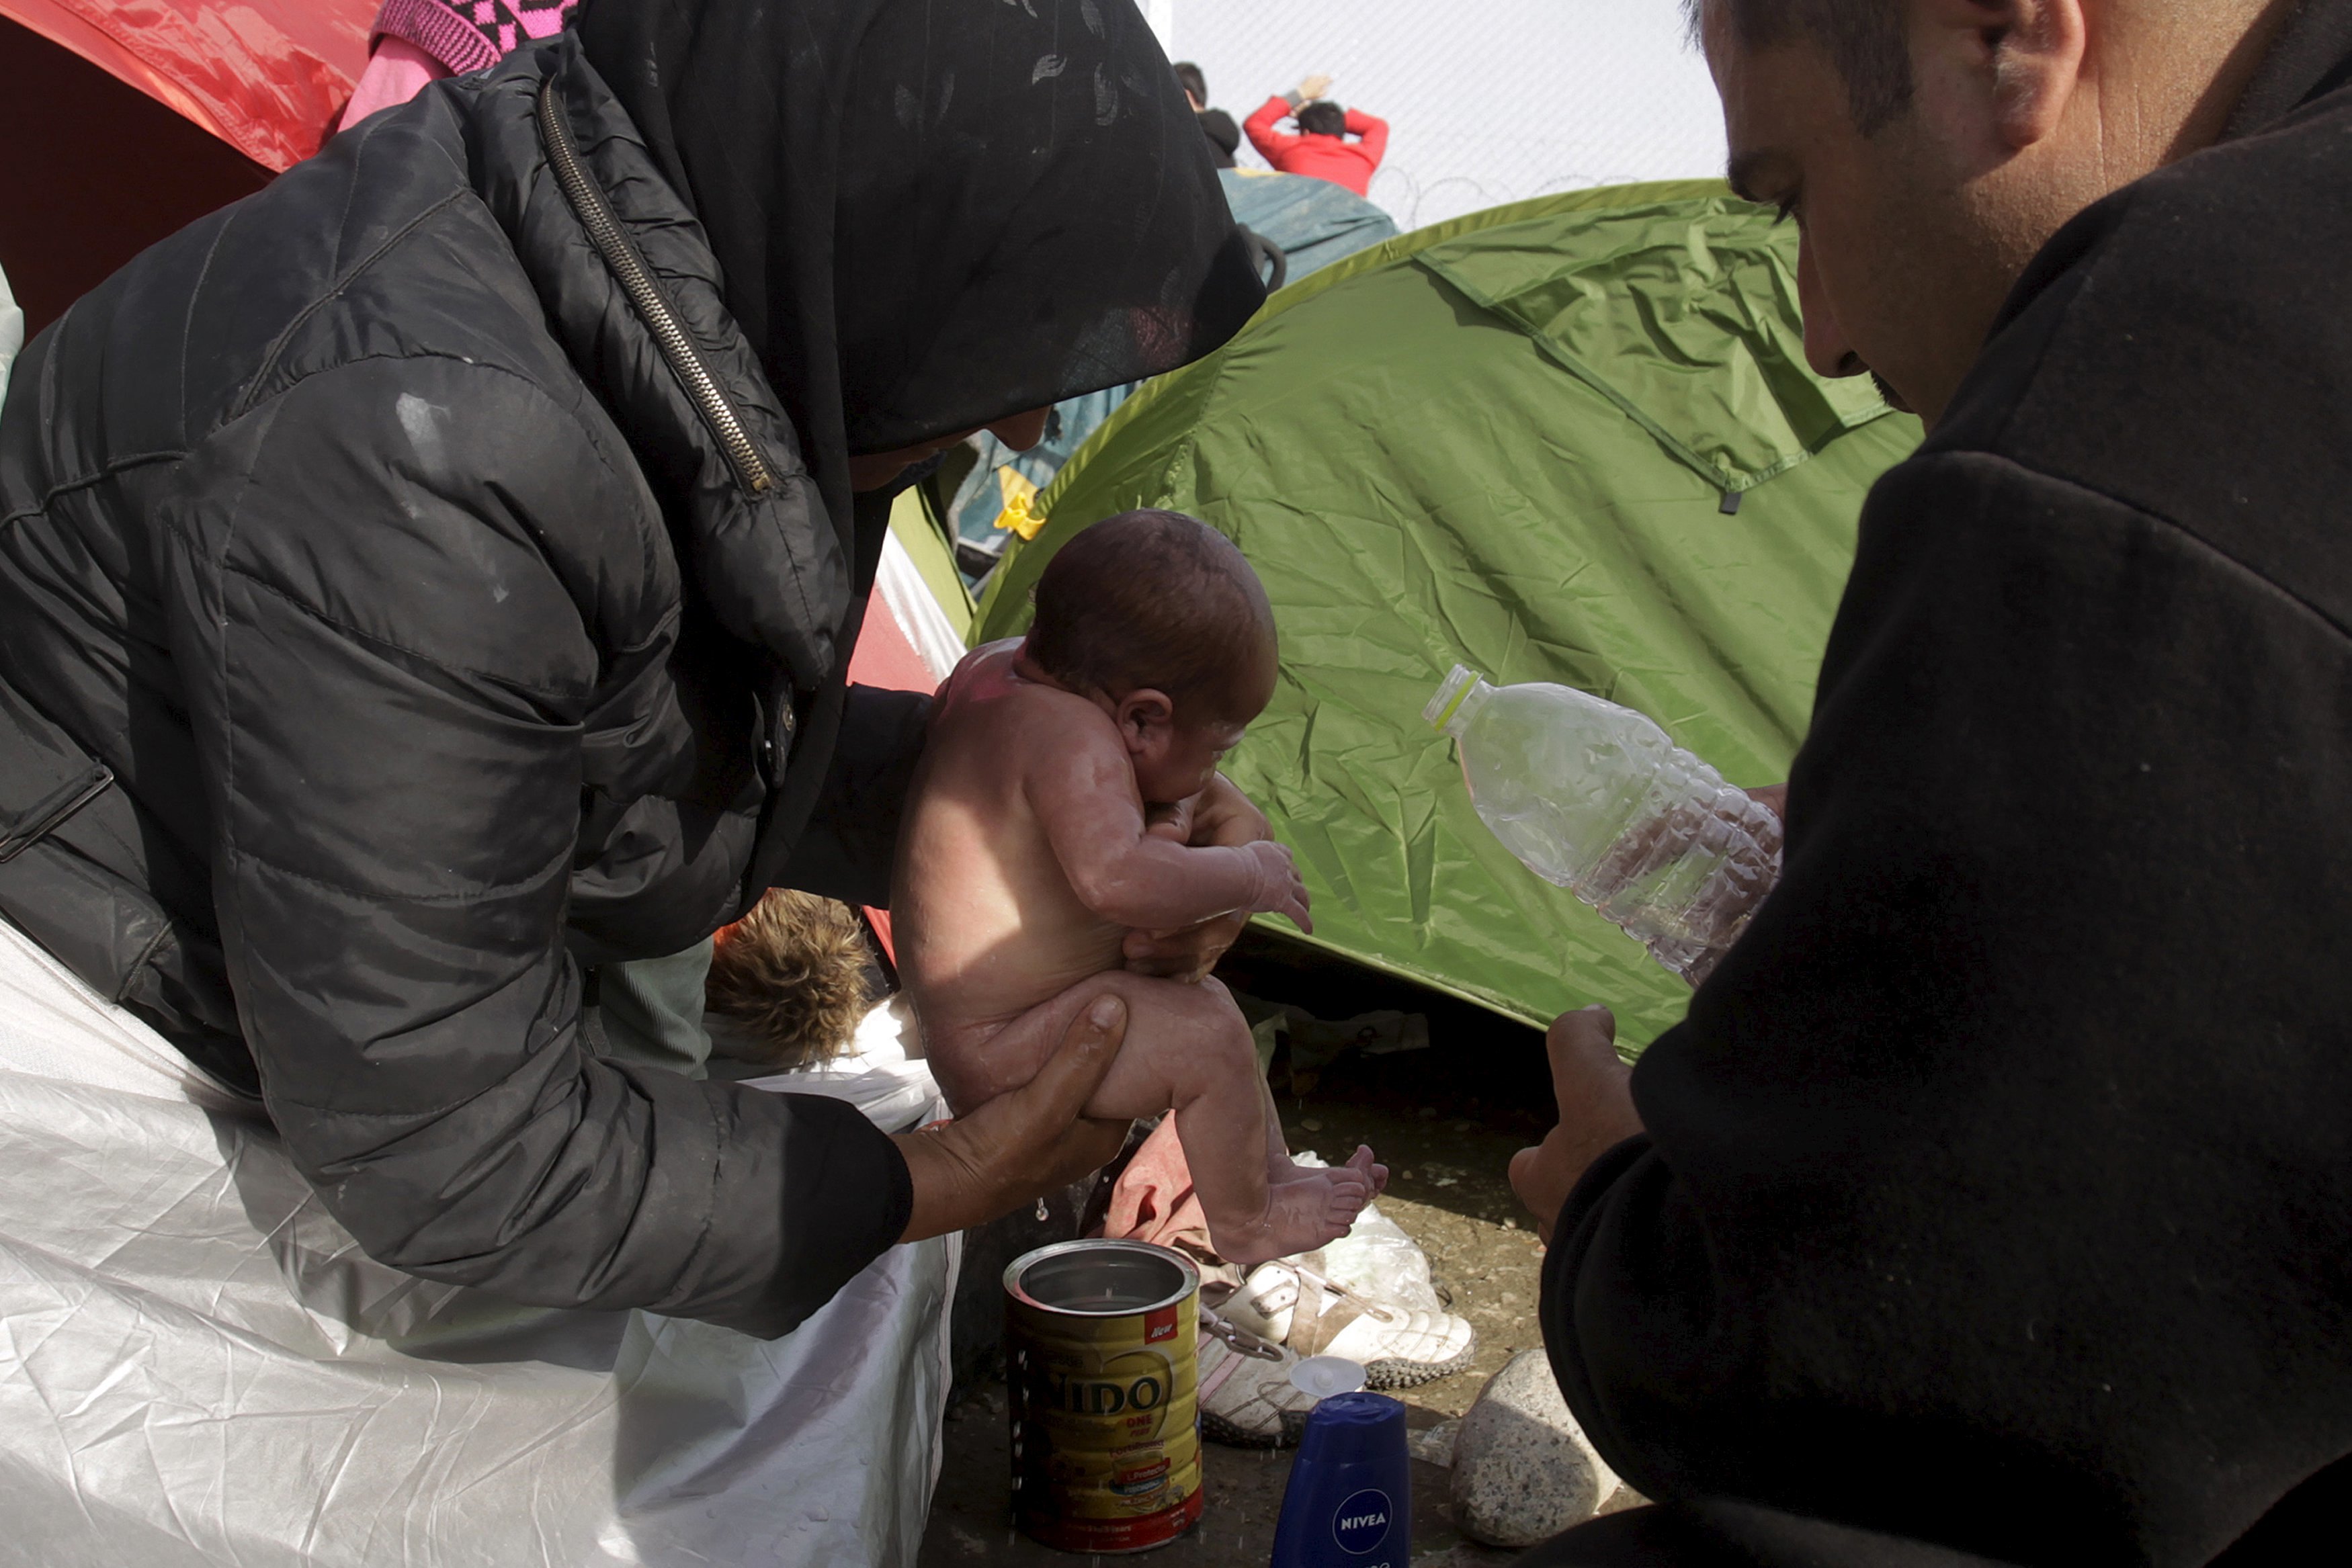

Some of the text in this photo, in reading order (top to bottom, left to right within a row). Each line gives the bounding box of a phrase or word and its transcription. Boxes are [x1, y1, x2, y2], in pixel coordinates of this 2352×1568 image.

[1150, 1323, 1173, 1338] New
[1126, 1413, 1152, 1428] ONE
[1341, 1512, 1386, 1530] NIVEA
